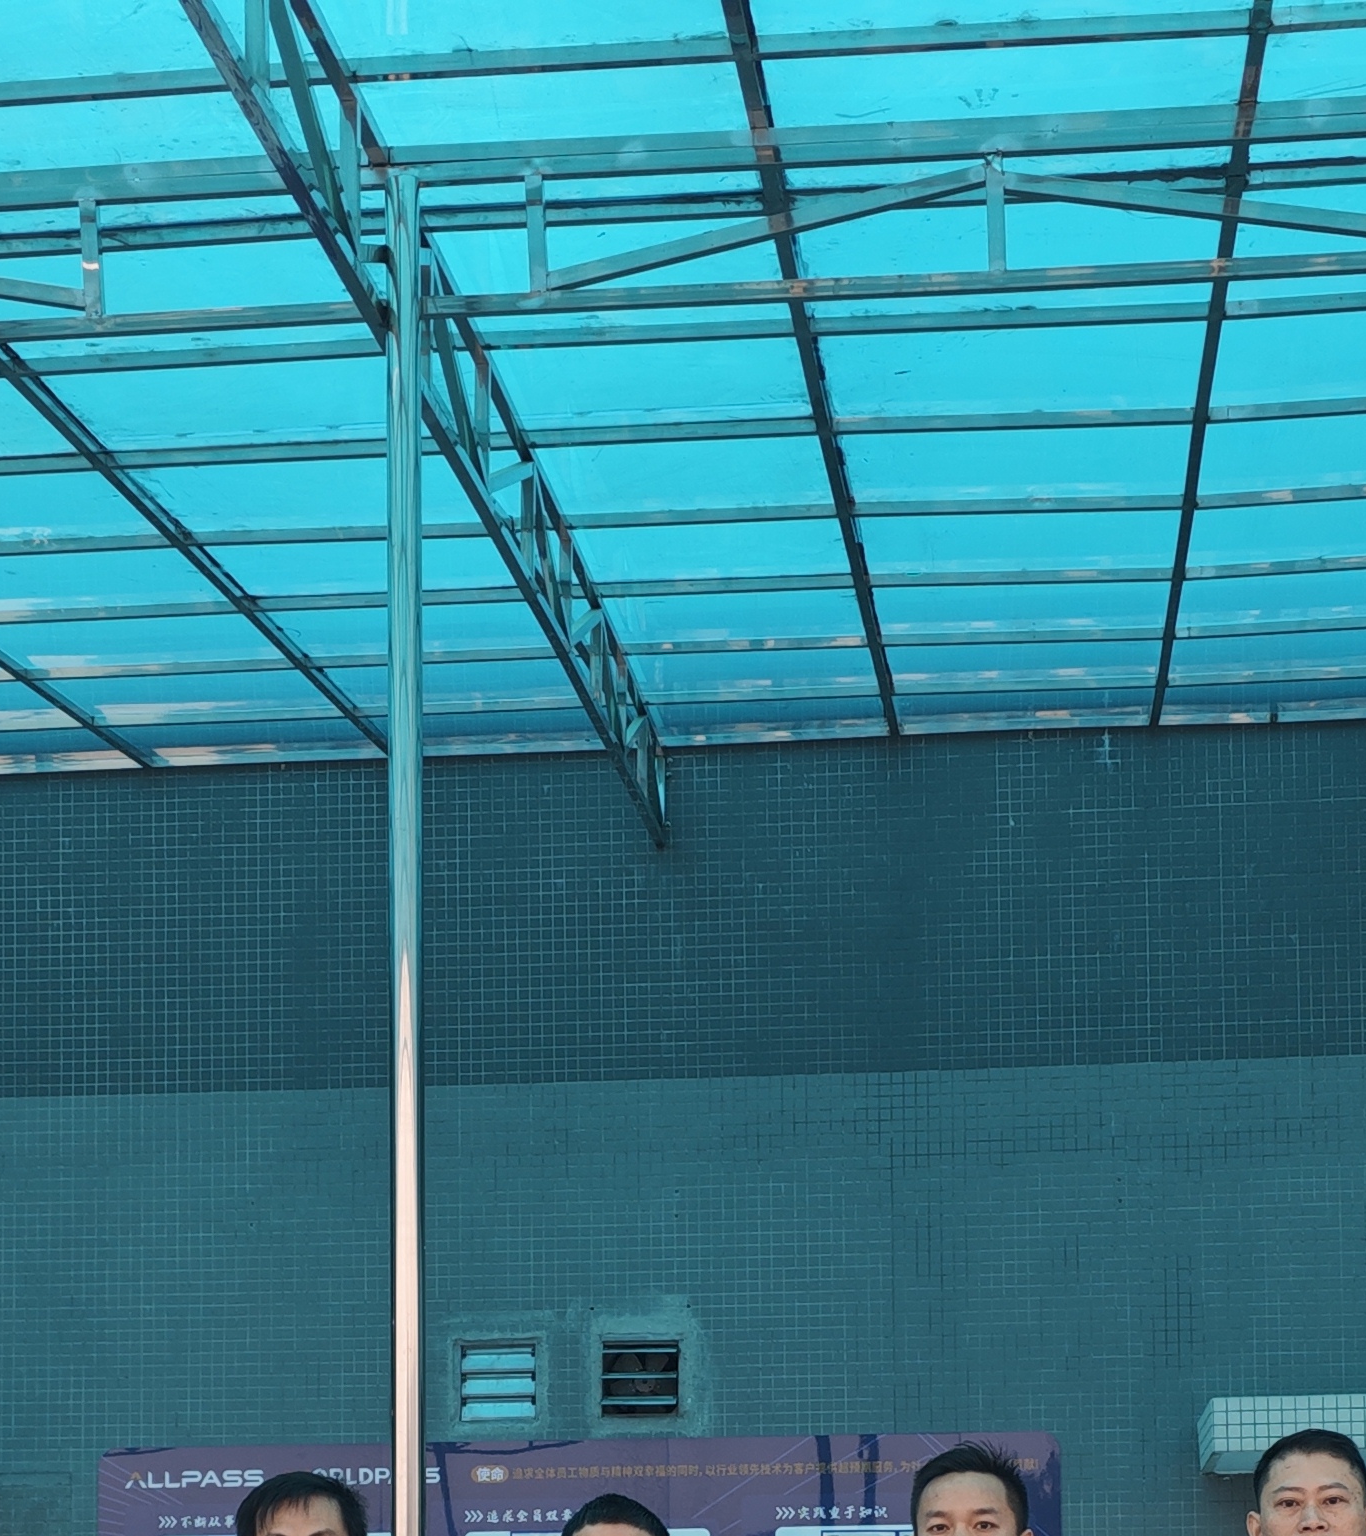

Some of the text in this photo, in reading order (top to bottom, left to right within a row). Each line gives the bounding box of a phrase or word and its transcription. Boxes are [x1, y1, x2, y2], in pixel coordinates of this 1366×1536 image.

[124, 1469, 265, 1489] ALLPASS
[476, 1467, 505, 1482] 使命
[798, 1505, 889, 1520] 实践重于知识
